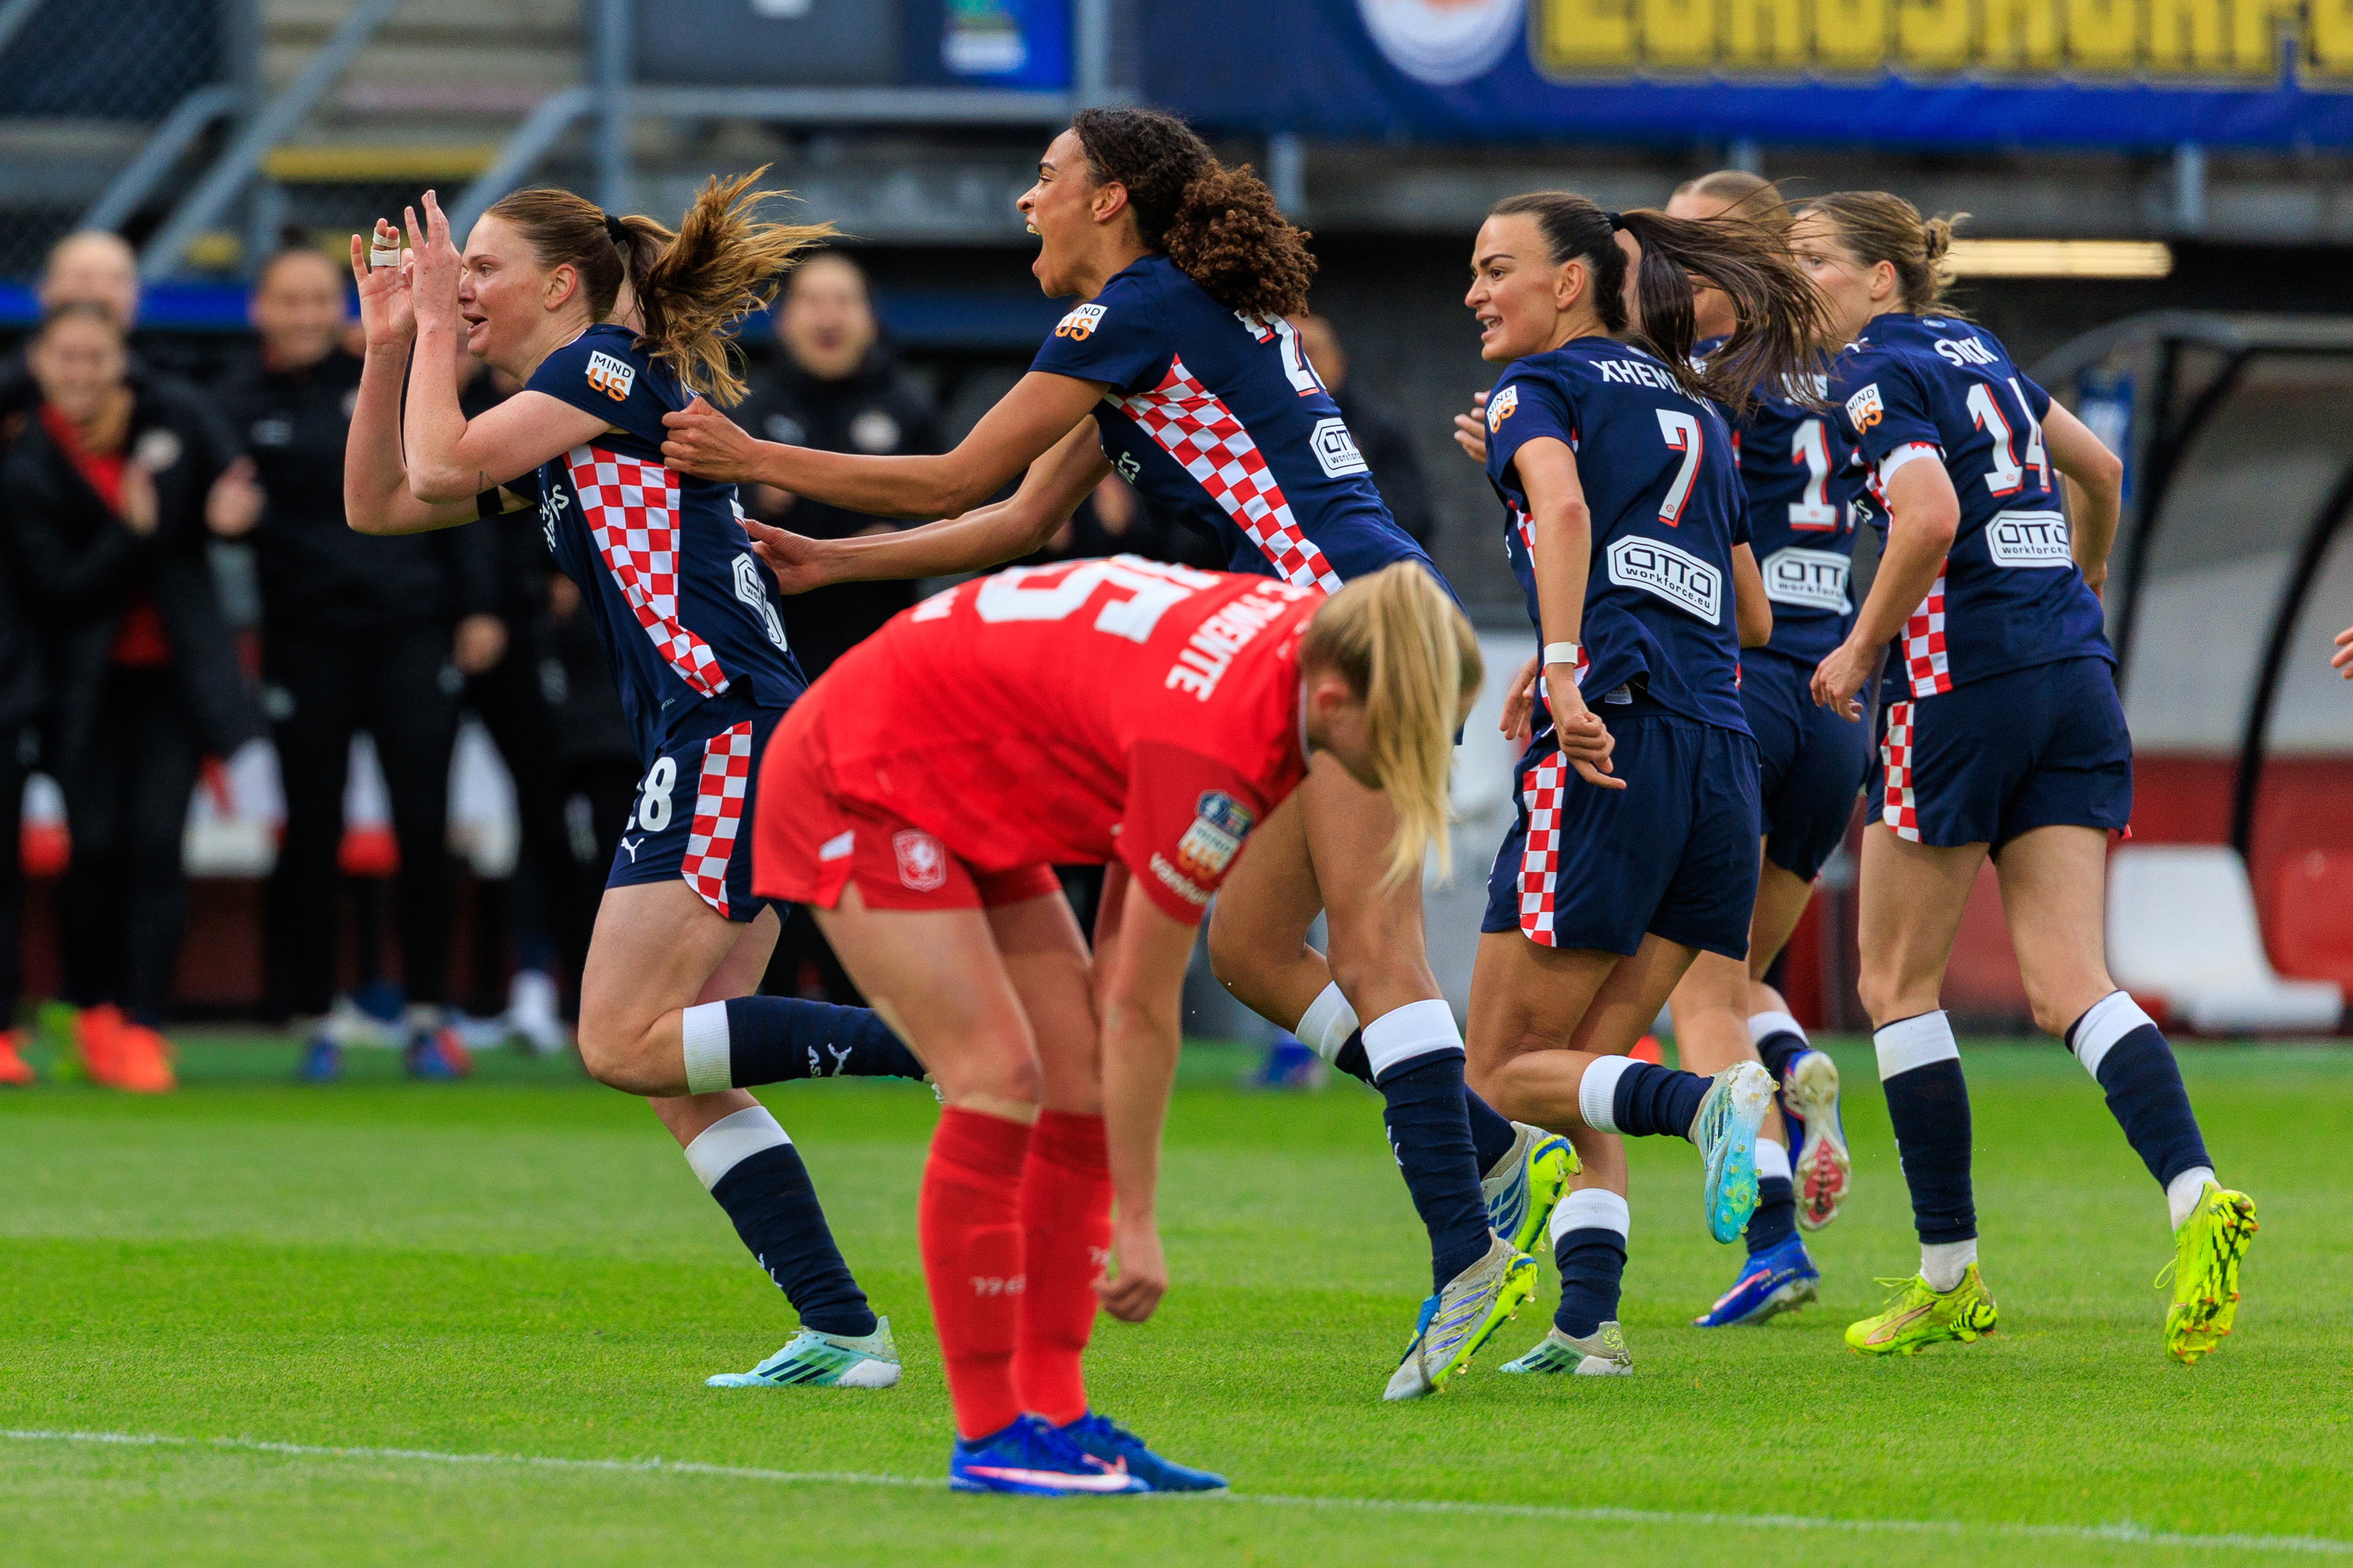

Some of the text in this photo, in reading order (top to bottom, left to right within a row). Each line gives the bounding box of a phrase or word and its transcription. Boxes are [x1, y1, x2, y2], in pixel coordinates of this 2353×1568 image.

[1056, 317, 1093, 341] US
[594, 355, 631, 378] MIND
[588, 367, 626, 402] US
[1849, 389, 1875, 414] MIND
[1492, 398, 1516, 433] US
[1855, 400, 1882, 435] US
[1966, 378, 2052, 498] 14
[1656, 408, 1703, 528] 7
[1789, 419, 1856, 533] 1
[1998, 523, 2068, 545] OTTO
[1624, 548, 1711, 598] OTTO
[1625, 568, 1711, 609] workforce.eu
[1778, 560, 1842, 587] OTT
[626, 757, 677, 832] 8
